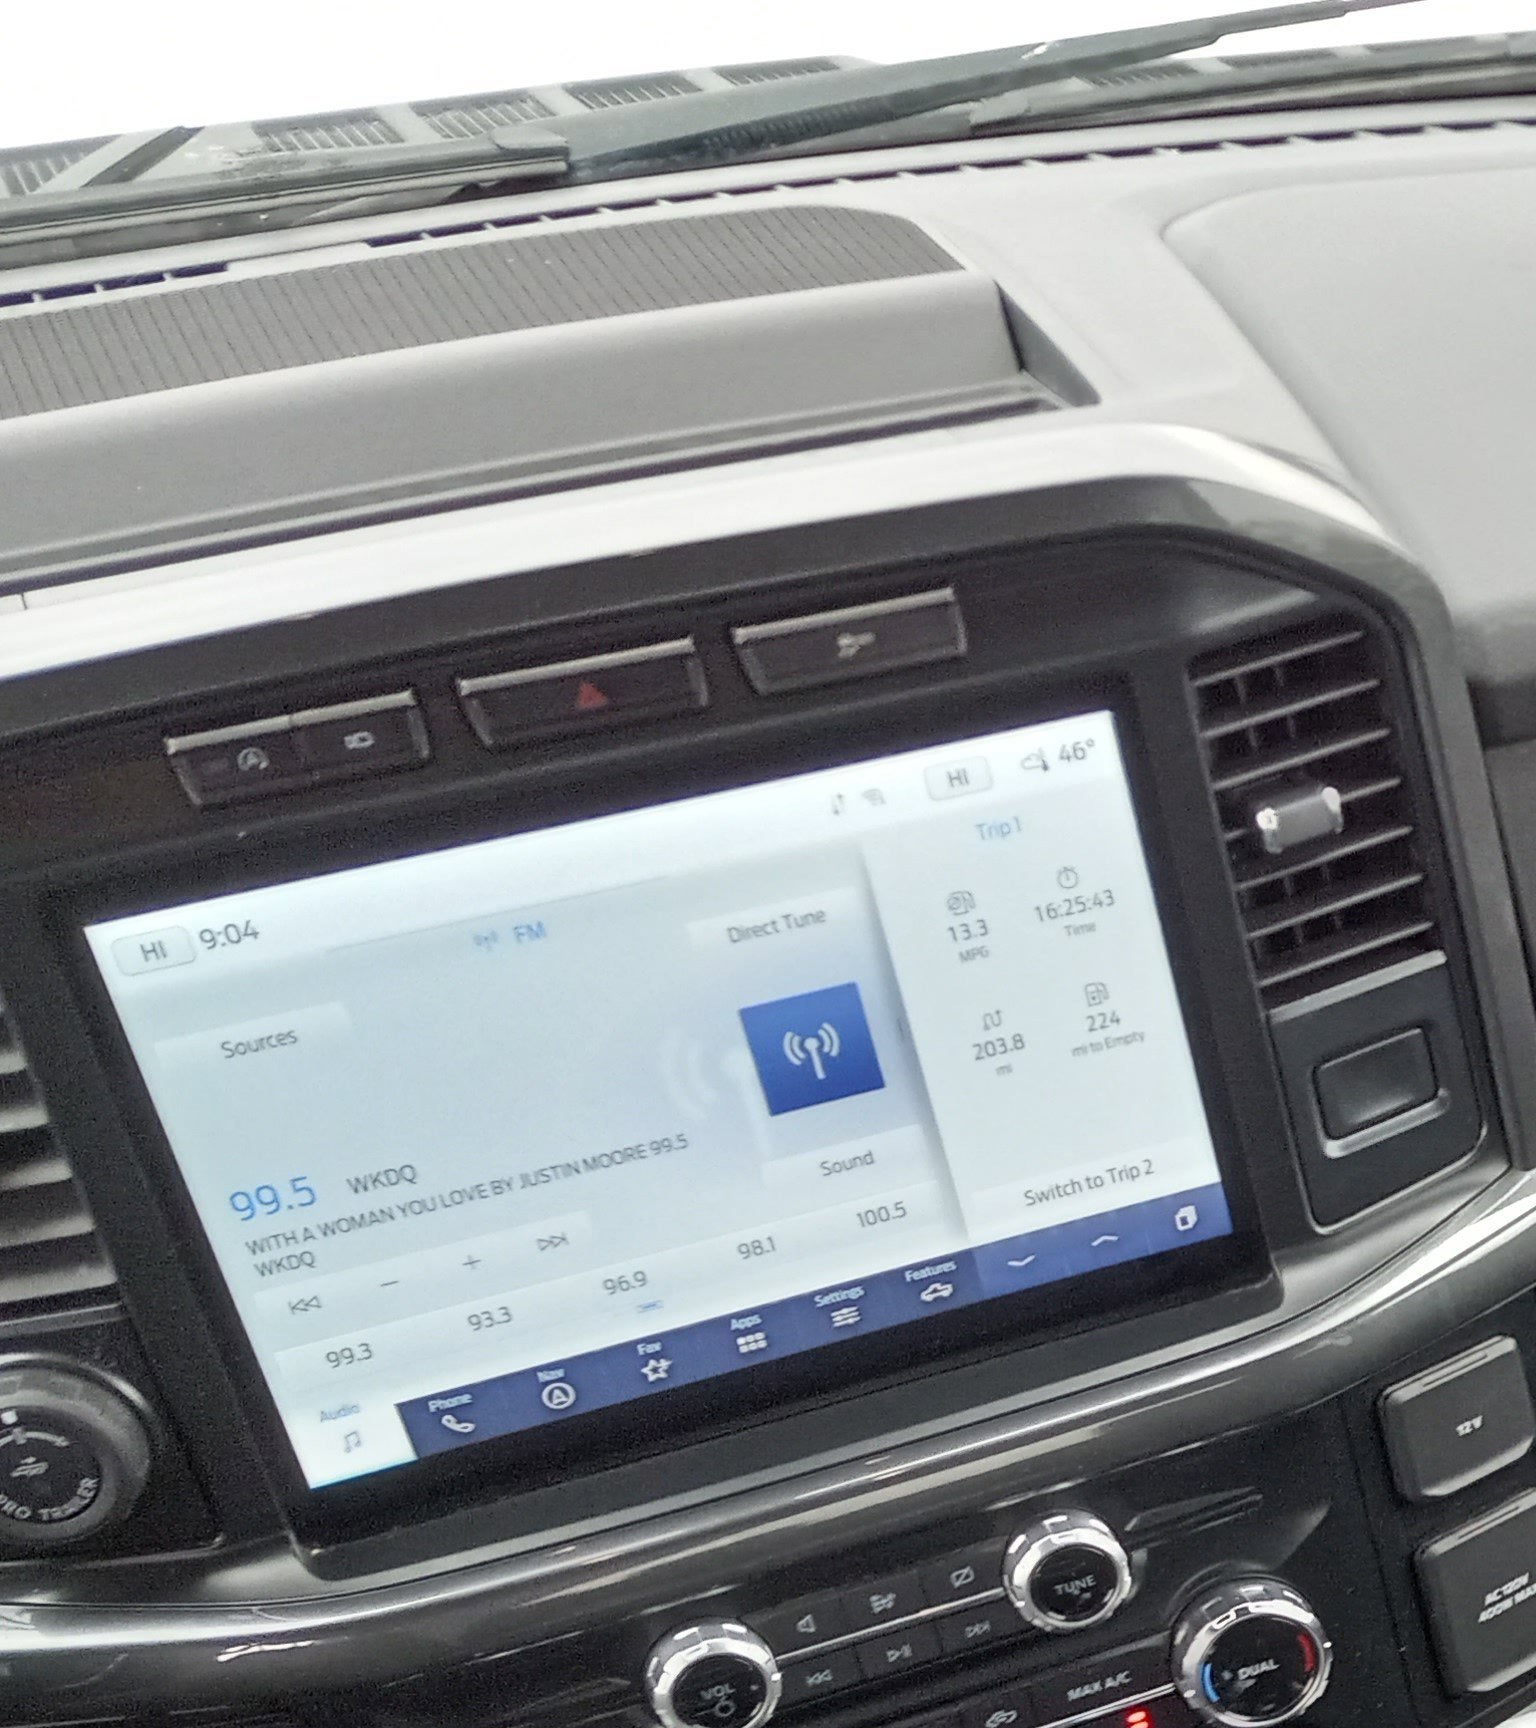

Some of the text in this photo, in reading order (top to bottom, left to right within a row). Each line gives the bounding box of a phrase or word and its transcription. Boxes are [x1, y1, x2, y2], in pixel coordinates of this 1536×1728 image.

[945, 767, 970, 788] HI
[1034, 889, 1116, 923] 16:25:43
[199, 920, 260, 950] 9:04
[512, 919, 547, 945] FM
[727, 906, 827, 945] Direct Tune
[948, 918, 989, 943] 13.3
[1063, 922, 1097, 937] Time
[140, 940, 167, 962] HI
[958, 945, 990, 964] MPG
[1085, 1010, 1121, 1033] 224
[220, 1029, 298, 1060] Sources
[972, 1032, 1026, 1062] 203.8
[820, 1149, 876, 1177] Sound
[345, 1163, 419, 1195] WKDQ
[1023, 1158, 1156, 1207] Switch to Trip 2
[228, 1175, 318, 1222] 99.5
[244, 1133, 690, 1256] WITH A WOMAN YOU LOVE BY JUSTIN MOORE 99.5
[856, 1200, 907, 1228] 100.5
[737, 1236, 778, 1260] 98.1
[253, 1250, 317, 1278] WKDQ
[904, 1260, 958, 1283] Features
[602, 1270, 648, 1296] 96.9
[814, 1285, 866, 1309] Settings
[467, 1306, 513, 1332] 93.3
[730, 1313, 763, 1333] Apps
[325, 1342, 374, 1369] 99.3
[1054, 1573, 1097, 1596] TUNE
[1236, 1657, 1281, 1681] DUAL
[700, 1682, 737, 1711] VOL
[1066, 1669, 1134, 1702] MAX A/C
